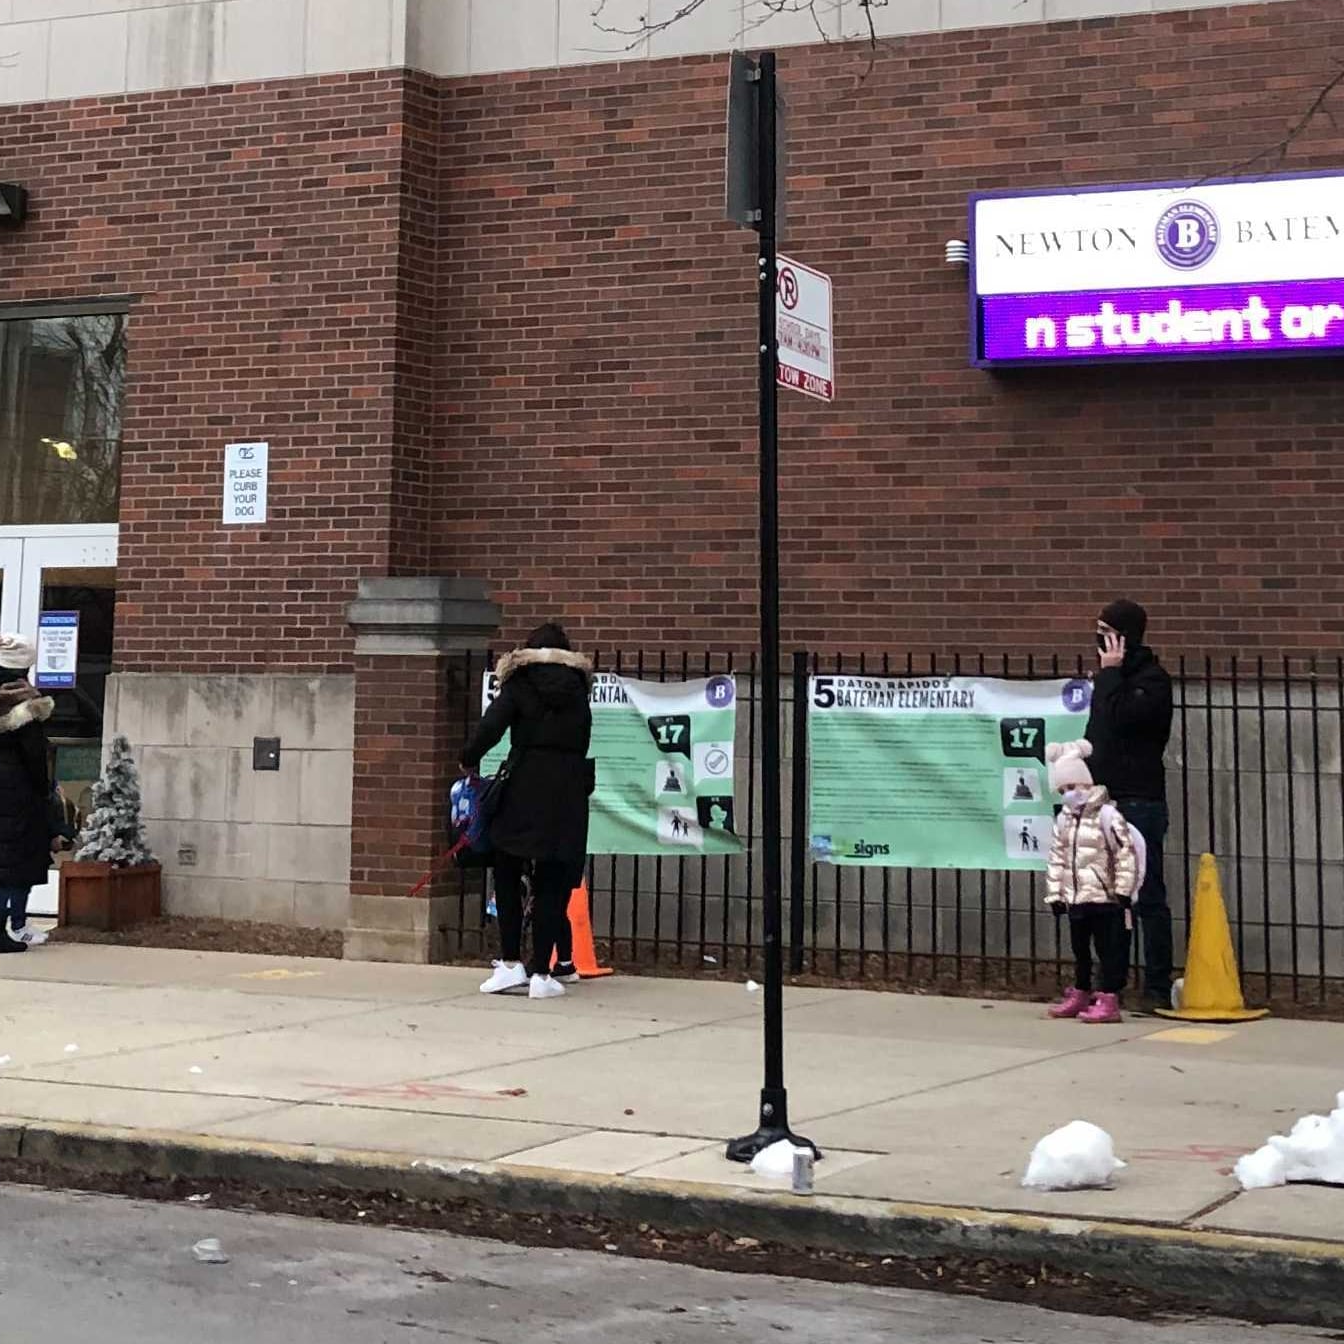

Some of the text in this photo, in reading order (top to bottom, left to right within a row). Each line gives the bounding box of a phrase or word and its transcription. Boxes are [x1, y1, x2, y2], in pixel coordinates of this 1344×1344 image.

[996, 227, 1136, 259] NEWTON
[1174, 218, 1201, 249] B
[1065, 296, 1272, 348] student
[778, 364, 830, 397] TOW ZONE
[229, 468, 263, 479] PLEASE
[233, 482, 258, 492] CURB
[233, 494, 257, 504] YOUR
[235, 506, 256, 517] DOG
[813, 678, 835, 708] 5
[836, 689, 975, 709] BATEMAN ELEMENTARY
[1071, 688, 1083, 704] B
[656, 724, 684, 745] 17
[1009, 727, 1038, 749] 17
[844, 839, 890, 858] signs
